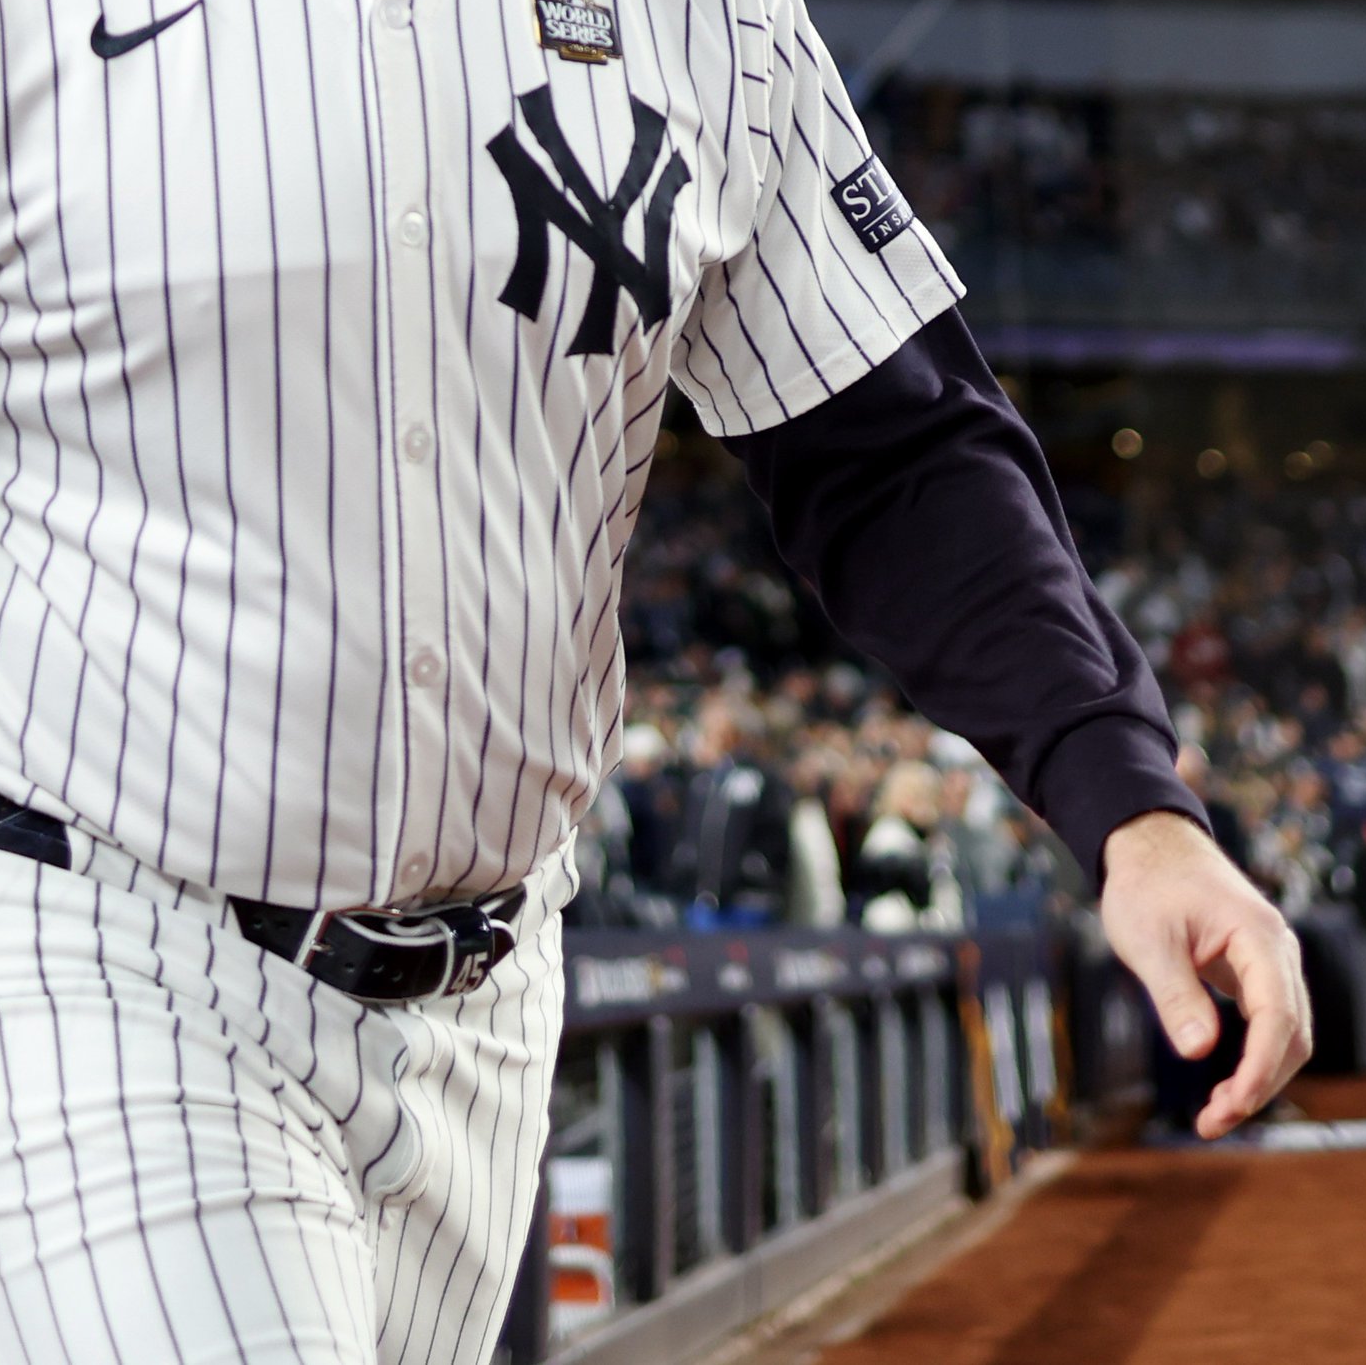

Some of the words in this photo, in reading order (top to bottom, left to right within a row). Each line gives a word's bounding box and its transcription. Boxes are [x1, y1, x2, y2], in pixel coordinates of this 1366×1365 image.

[538, 0, 611, 30] WORLD
[546, 19, 613, 47] SERIES
[842, 167, 893, 222] ST
[485, 83, 692, 357] NY
[450, 951, 488, 995] 45
